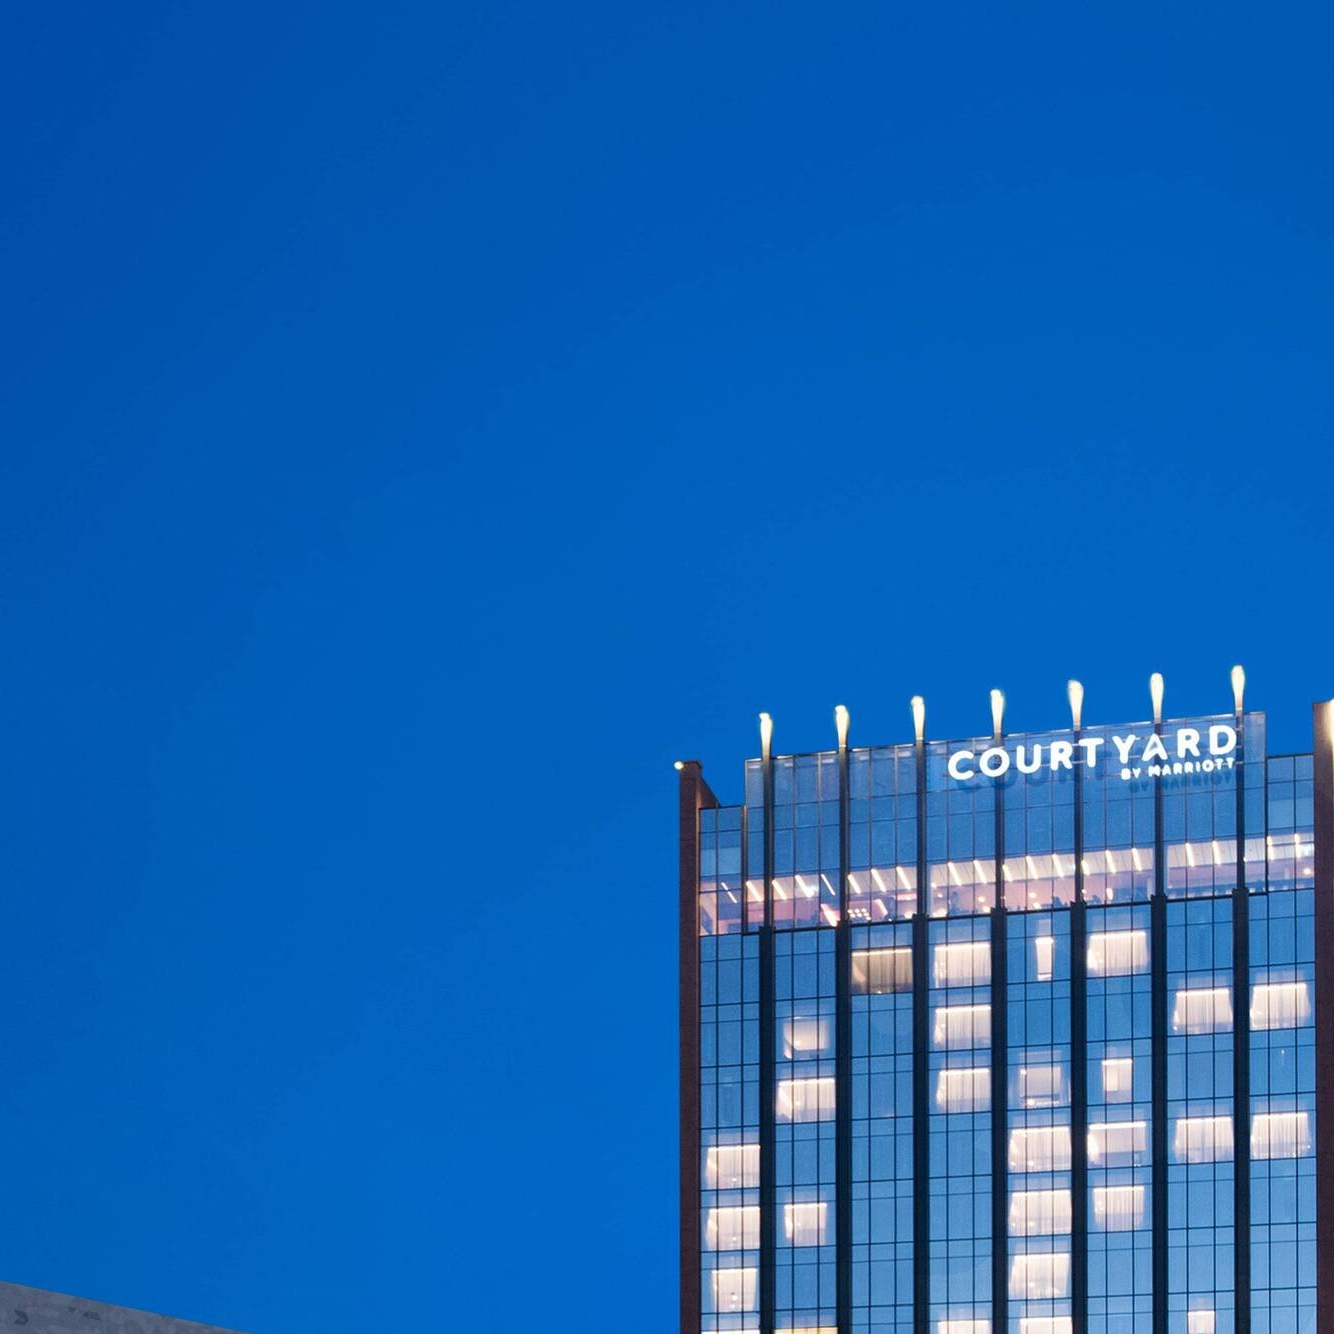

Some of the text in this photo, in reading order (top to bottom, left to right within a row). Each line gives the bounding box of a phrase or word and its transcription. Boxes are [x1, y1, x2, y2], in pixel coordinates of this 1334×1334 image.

[948, 725, 1237, 780] COURTYARD
[1120, 757, 1235, 780] BY MARRIOTT
